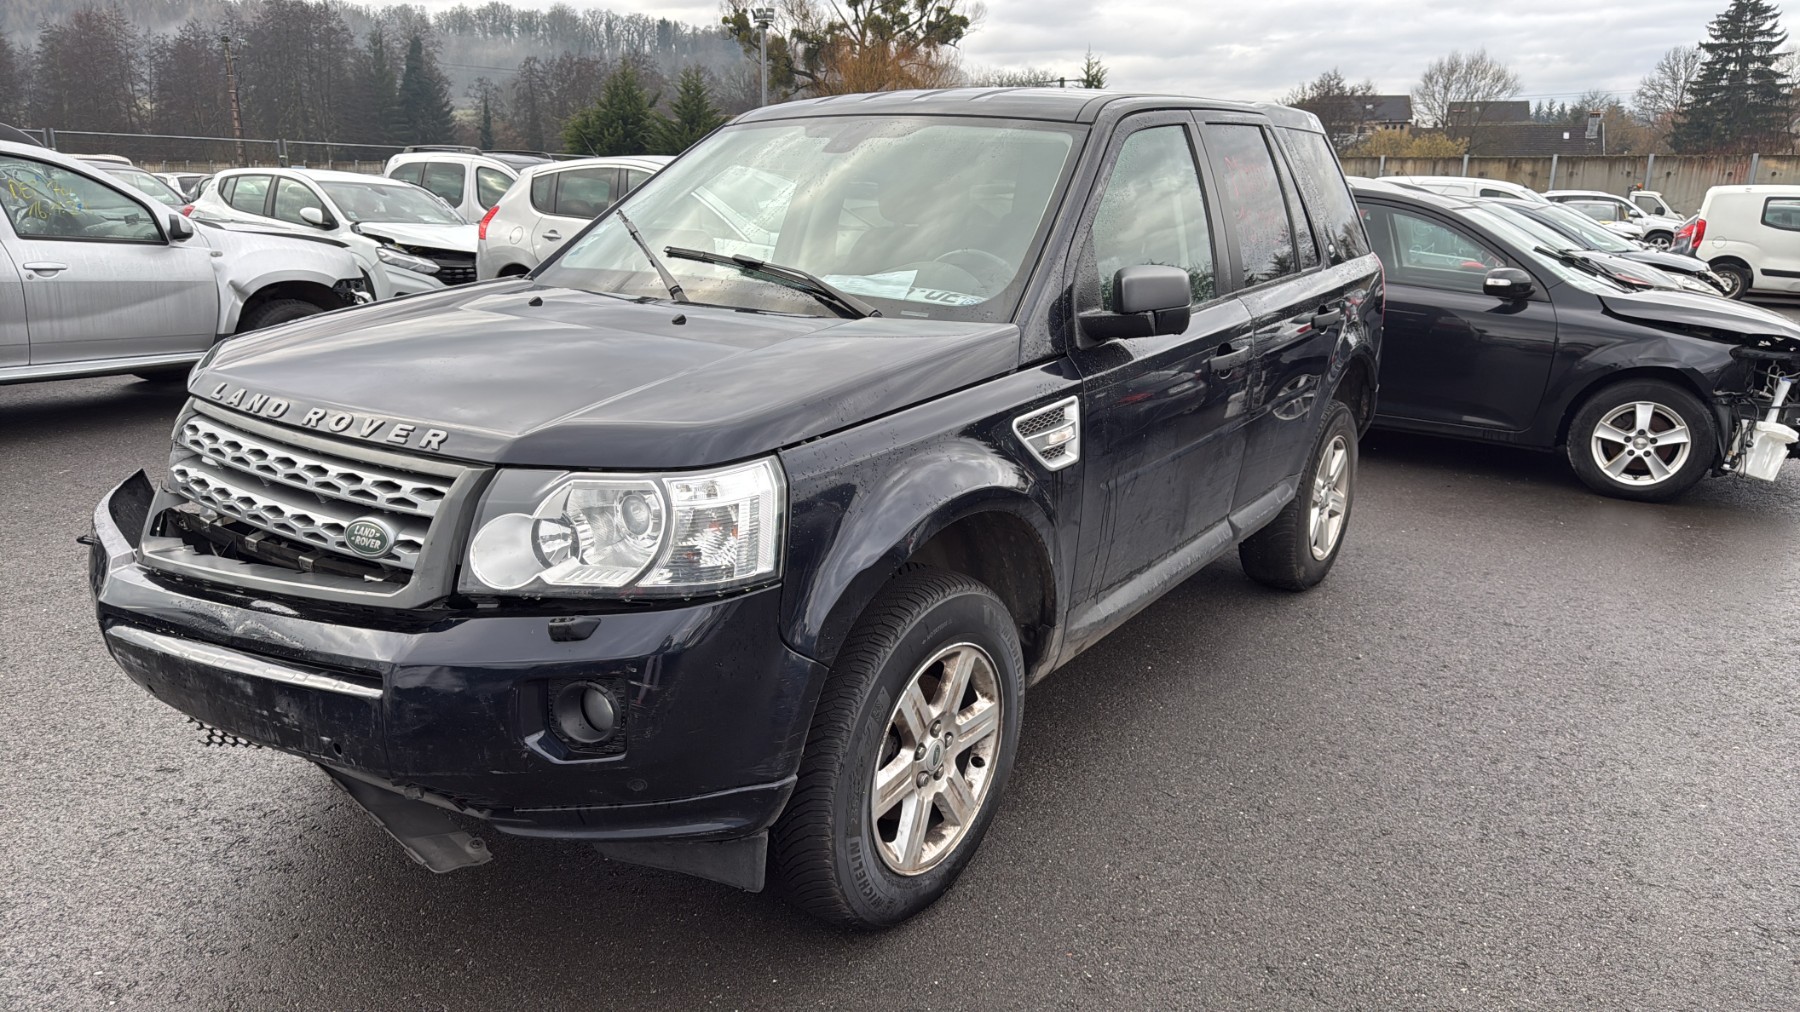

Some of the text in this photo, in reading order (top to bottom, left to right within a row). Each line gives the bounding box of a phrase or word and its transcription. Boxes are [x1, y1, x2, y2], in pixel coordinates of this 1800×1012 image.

[210, 382, 449, 450] LAND ROVER
[354, 525, 376, 538] LAND
[355, 535, 381, 549] ROVER
[849, 841, 886, 909] MICHELIN
